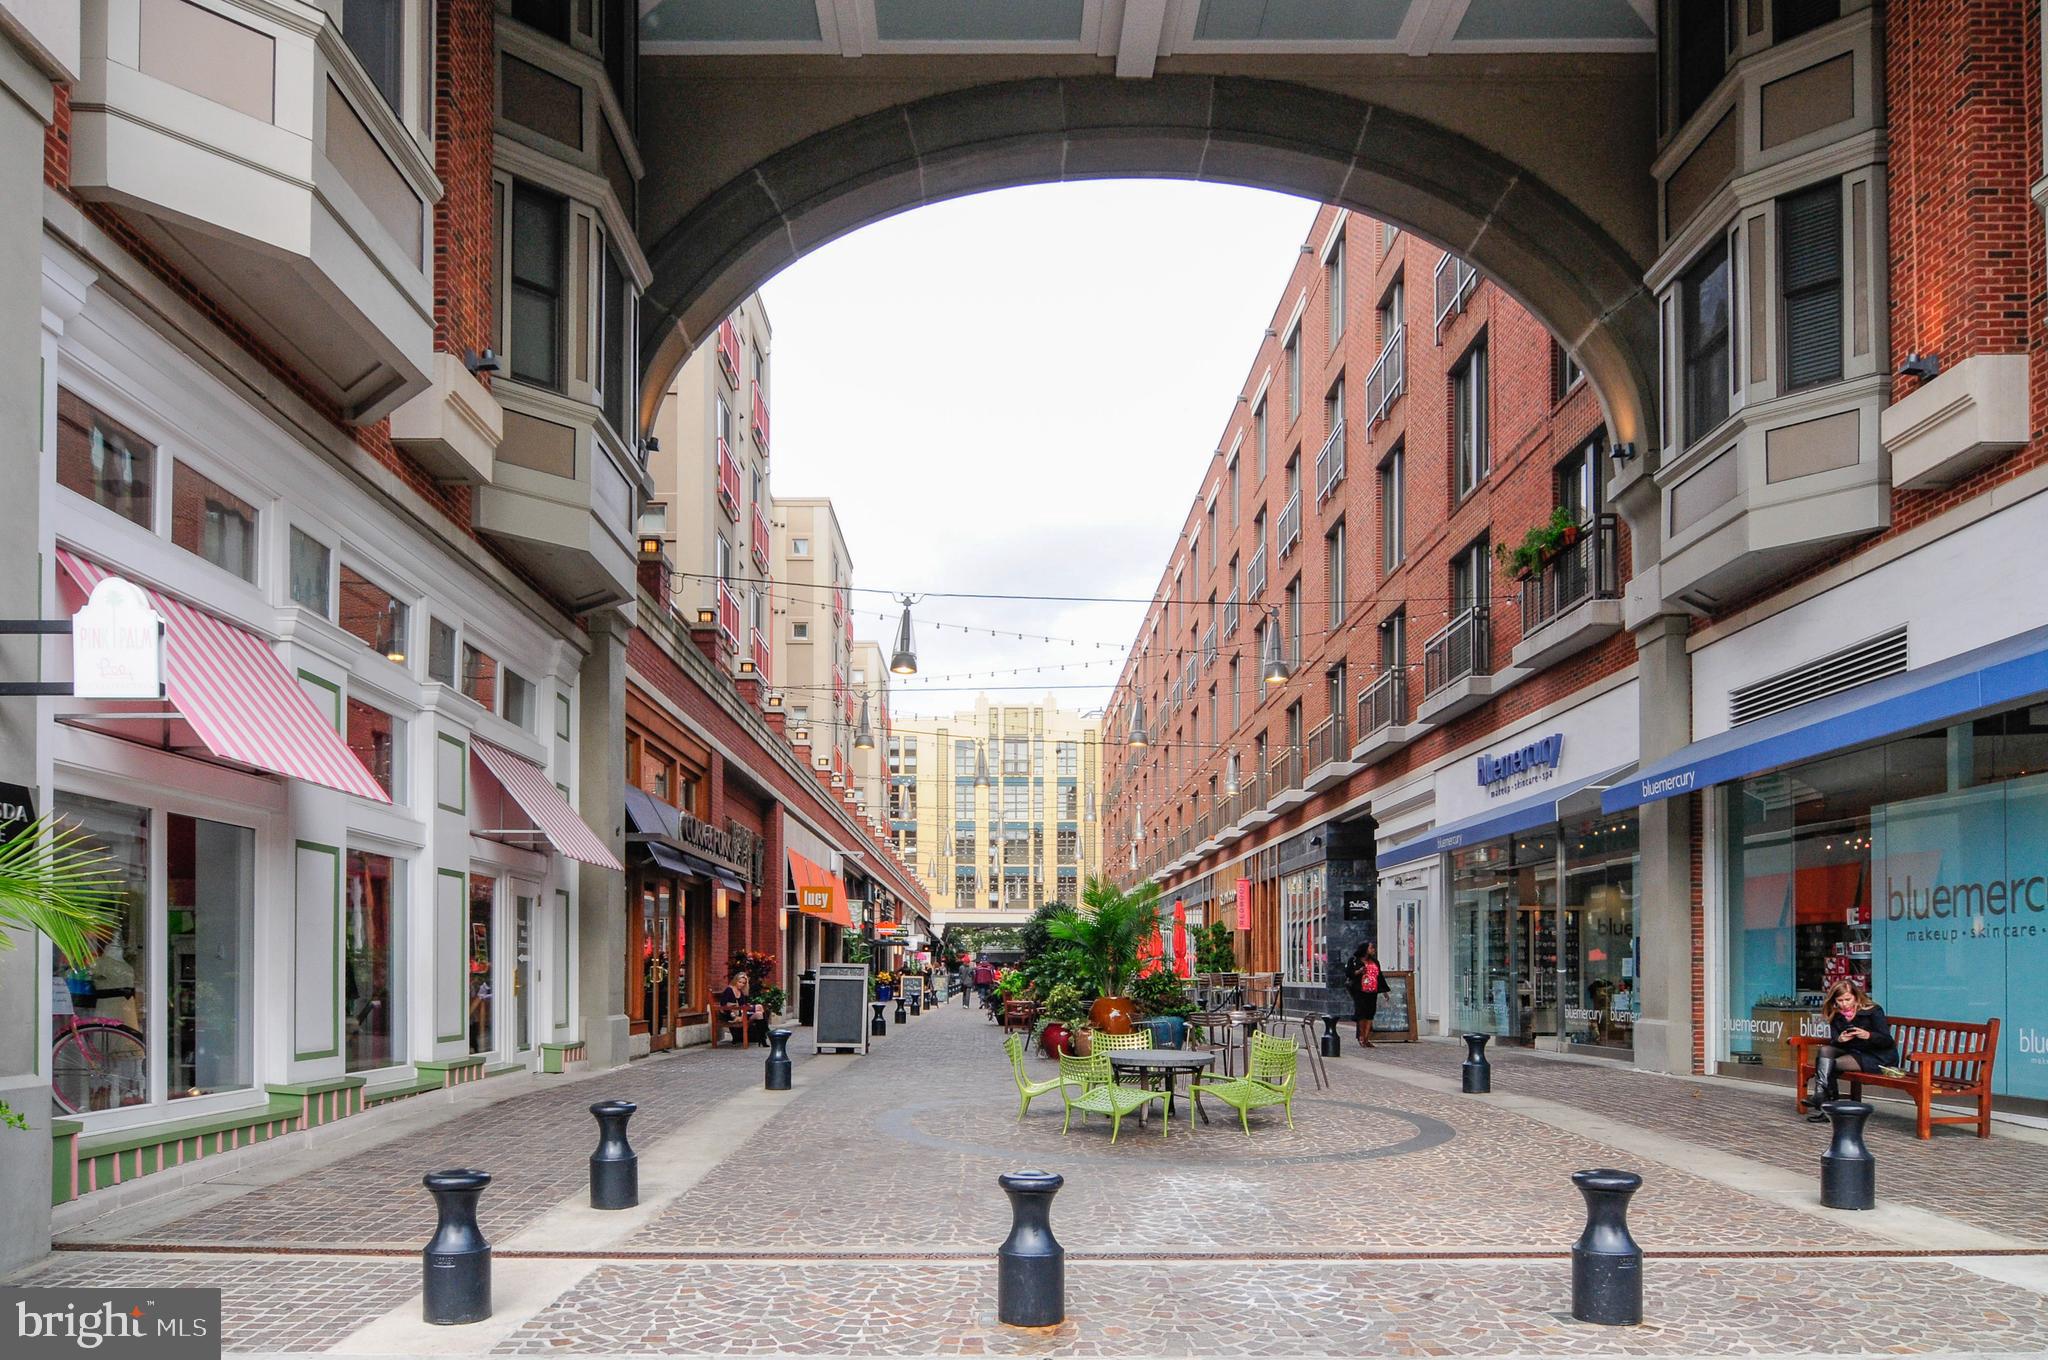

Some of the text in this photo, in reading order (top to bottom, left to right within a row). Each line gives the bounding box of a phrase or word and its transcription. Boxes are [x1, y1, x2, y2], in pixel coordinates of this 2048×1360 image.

[80, 624, 153, 649] PINK PALM
[1641, 770, 1696, 798] bluemercury
[0, 802, 28, 823] DA
[803, 890, 829, 909] lucy
[1888, 874, 2048, 921] bluemerc
[1906, 922, 2037, 944] makeup skincare
[1564, 1005, 1603, 1024] bluemercury
[1721, 1016, 1784, 1039] bluemercury
[2019, 1027, 2048, 1054] blu
